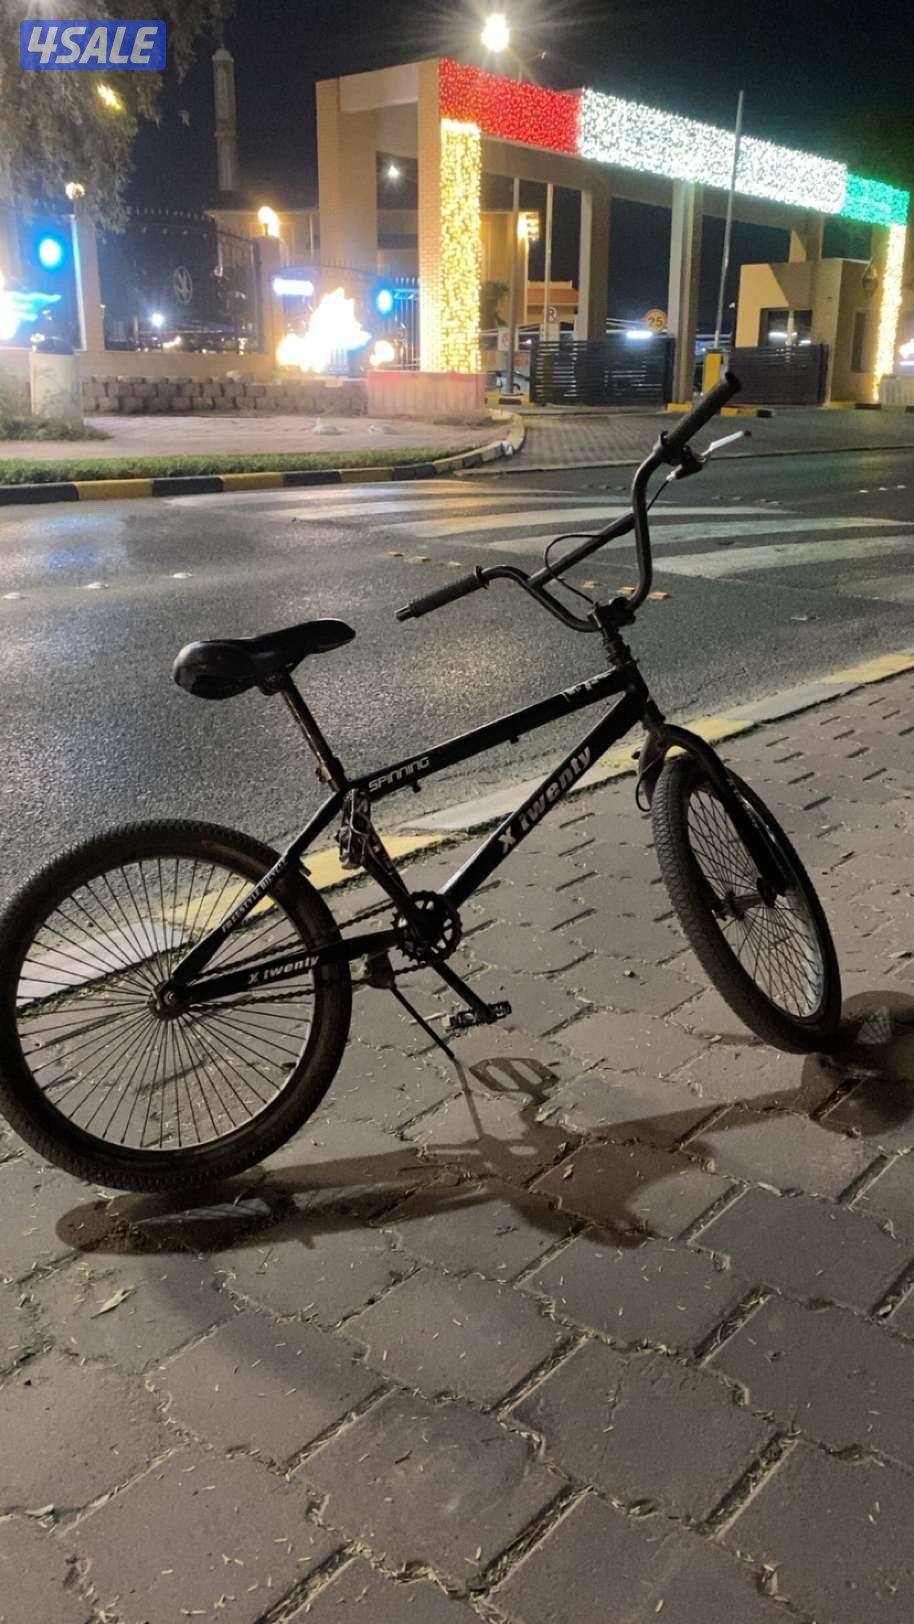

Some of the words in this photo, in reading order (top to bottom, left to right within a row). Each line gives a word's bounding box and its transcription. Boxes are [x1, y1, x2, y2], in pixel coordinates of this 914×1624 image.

[498, 825, 517, 854] X
[519, 746, 591, 832] twenty
[248, 971, 260, 985] X
[263, 955, 320, 980] twenty
